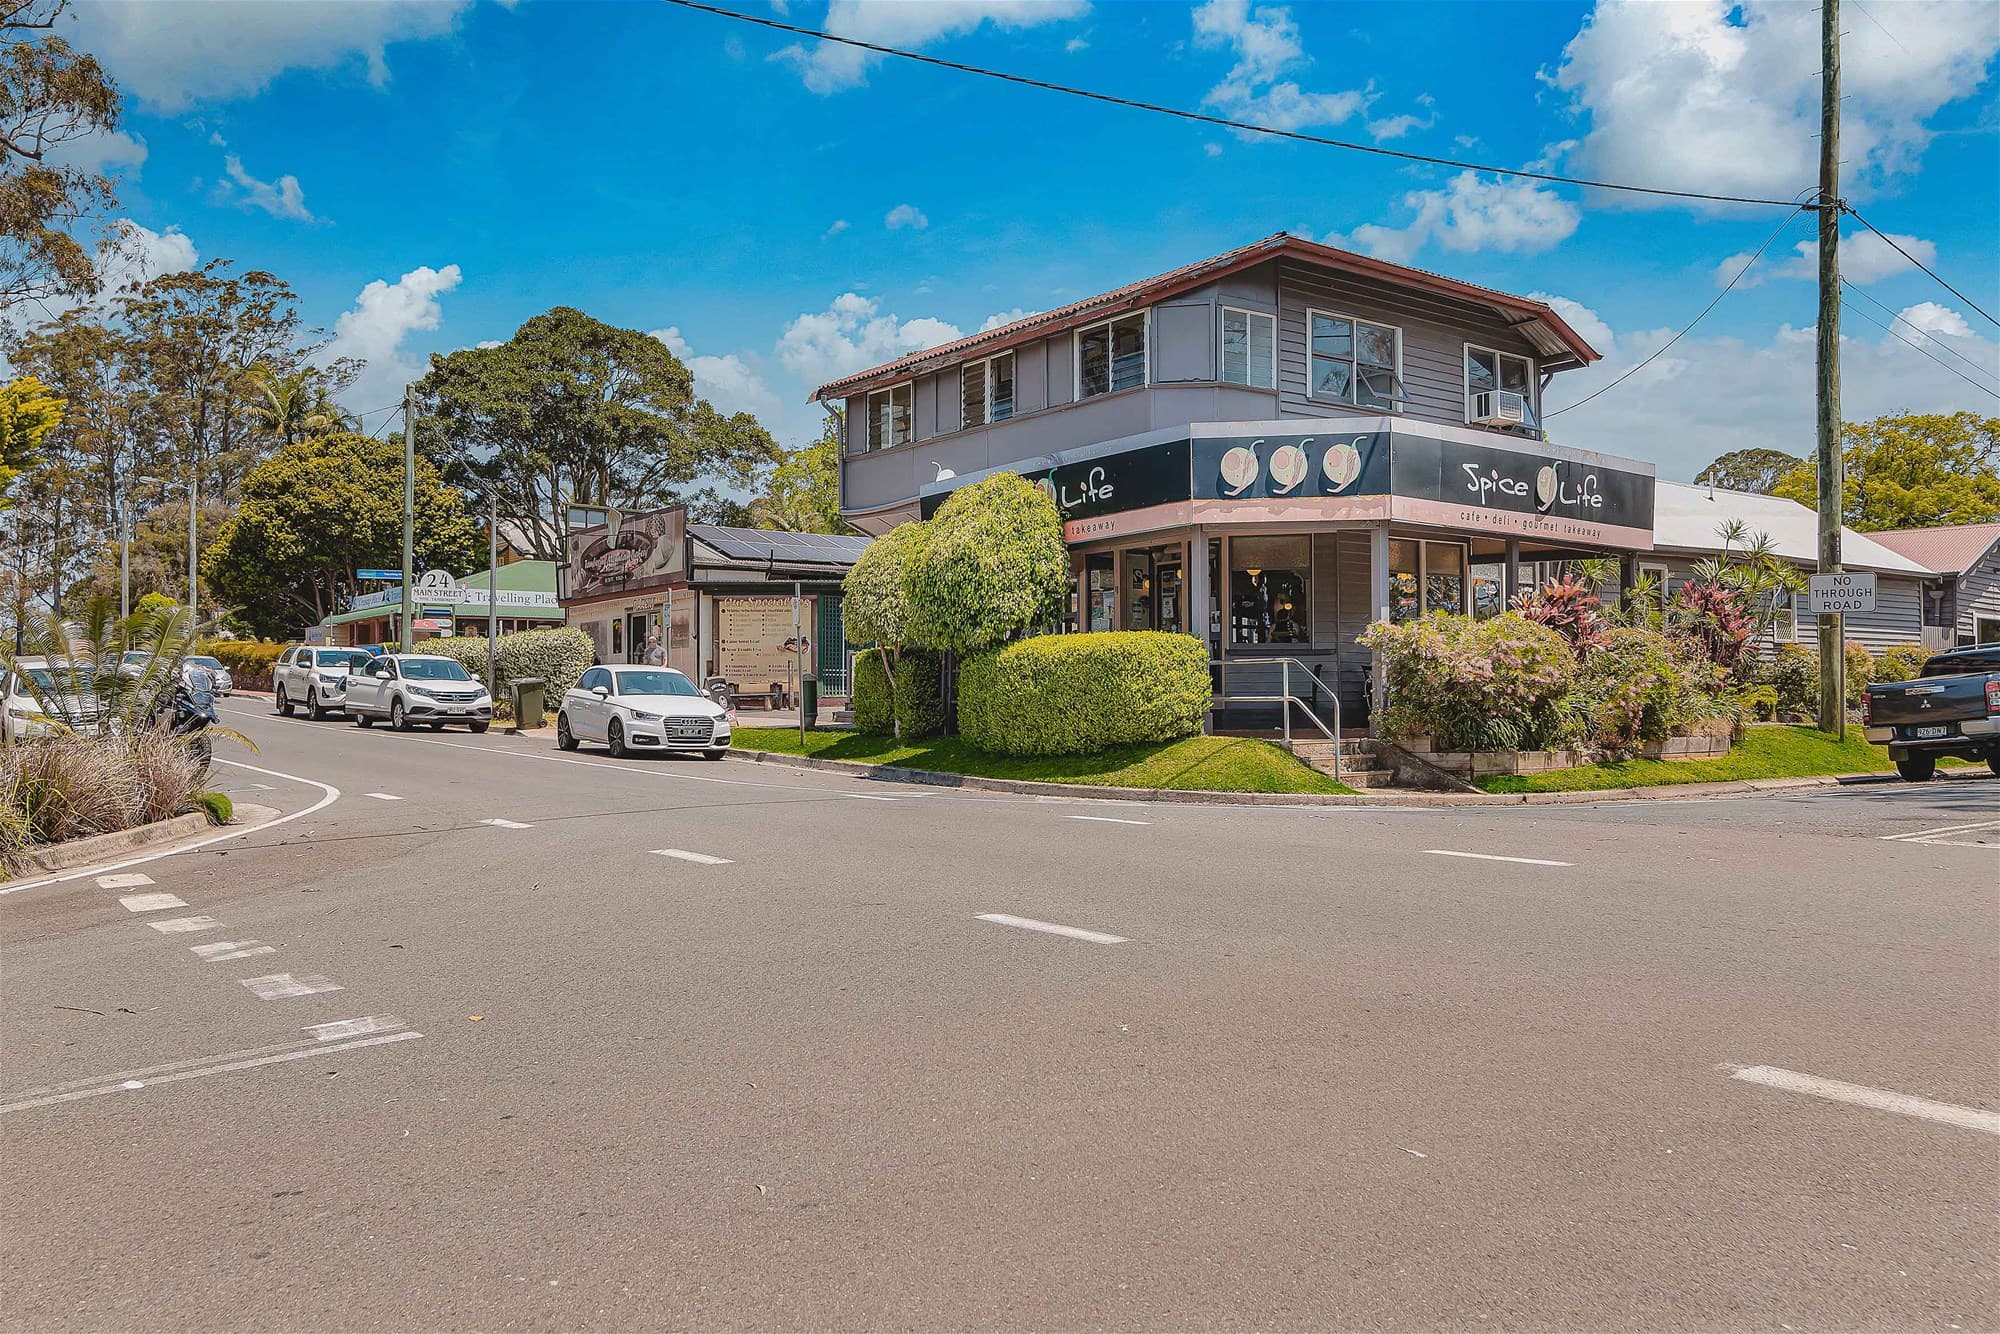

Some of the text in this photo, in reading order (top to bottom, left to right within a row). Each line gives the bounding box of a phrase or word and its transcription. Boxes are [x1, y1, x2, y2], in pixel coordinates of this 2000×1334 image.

[1061, 466, 1114, 508] Life
[1462, 463, 1603, 508] Spice Life
[1071, 518, 1117, 536] takeaway
[1460, 511, 1602, 540] cafe deli gourmet takeaway
[427, 573, 449, 588] 24
[1833, 576, 1851, 586] NO
[433, 589, 462, 597] STREET
[475, 591, 558, 605] Trvelling Plac
[1814, 588, 1872, 599] THROUGH
[1823, 601, 1862, 610] ROAD
